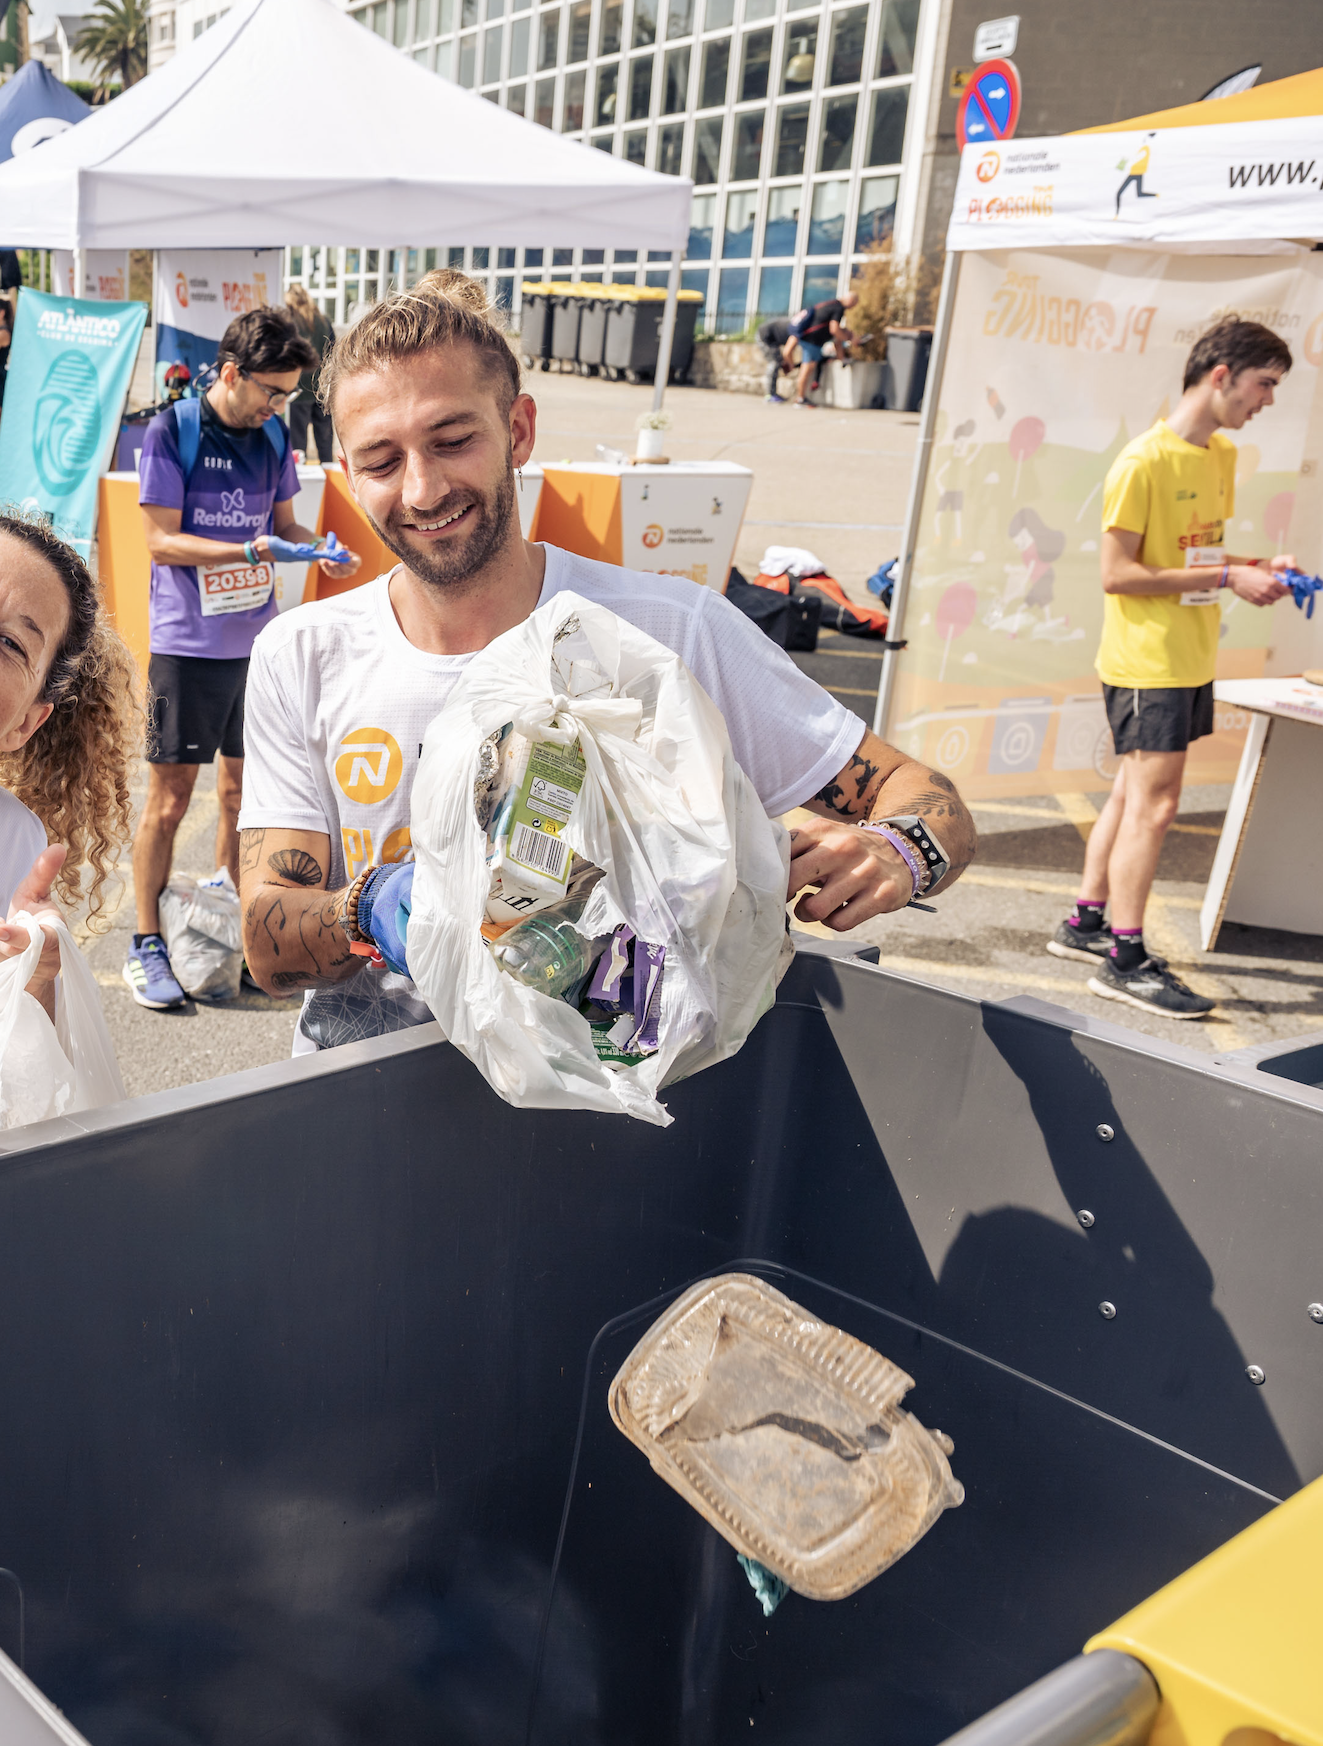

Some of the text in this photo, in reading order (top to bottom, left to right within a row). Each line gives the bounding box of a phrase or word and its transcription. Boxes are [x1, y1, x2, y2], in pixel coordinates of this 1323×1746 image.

[1229, 160, 1323, 191] www.
[966, 193, 1054, 222] PLOGGING
[208, 567, 268, 592] 20398
